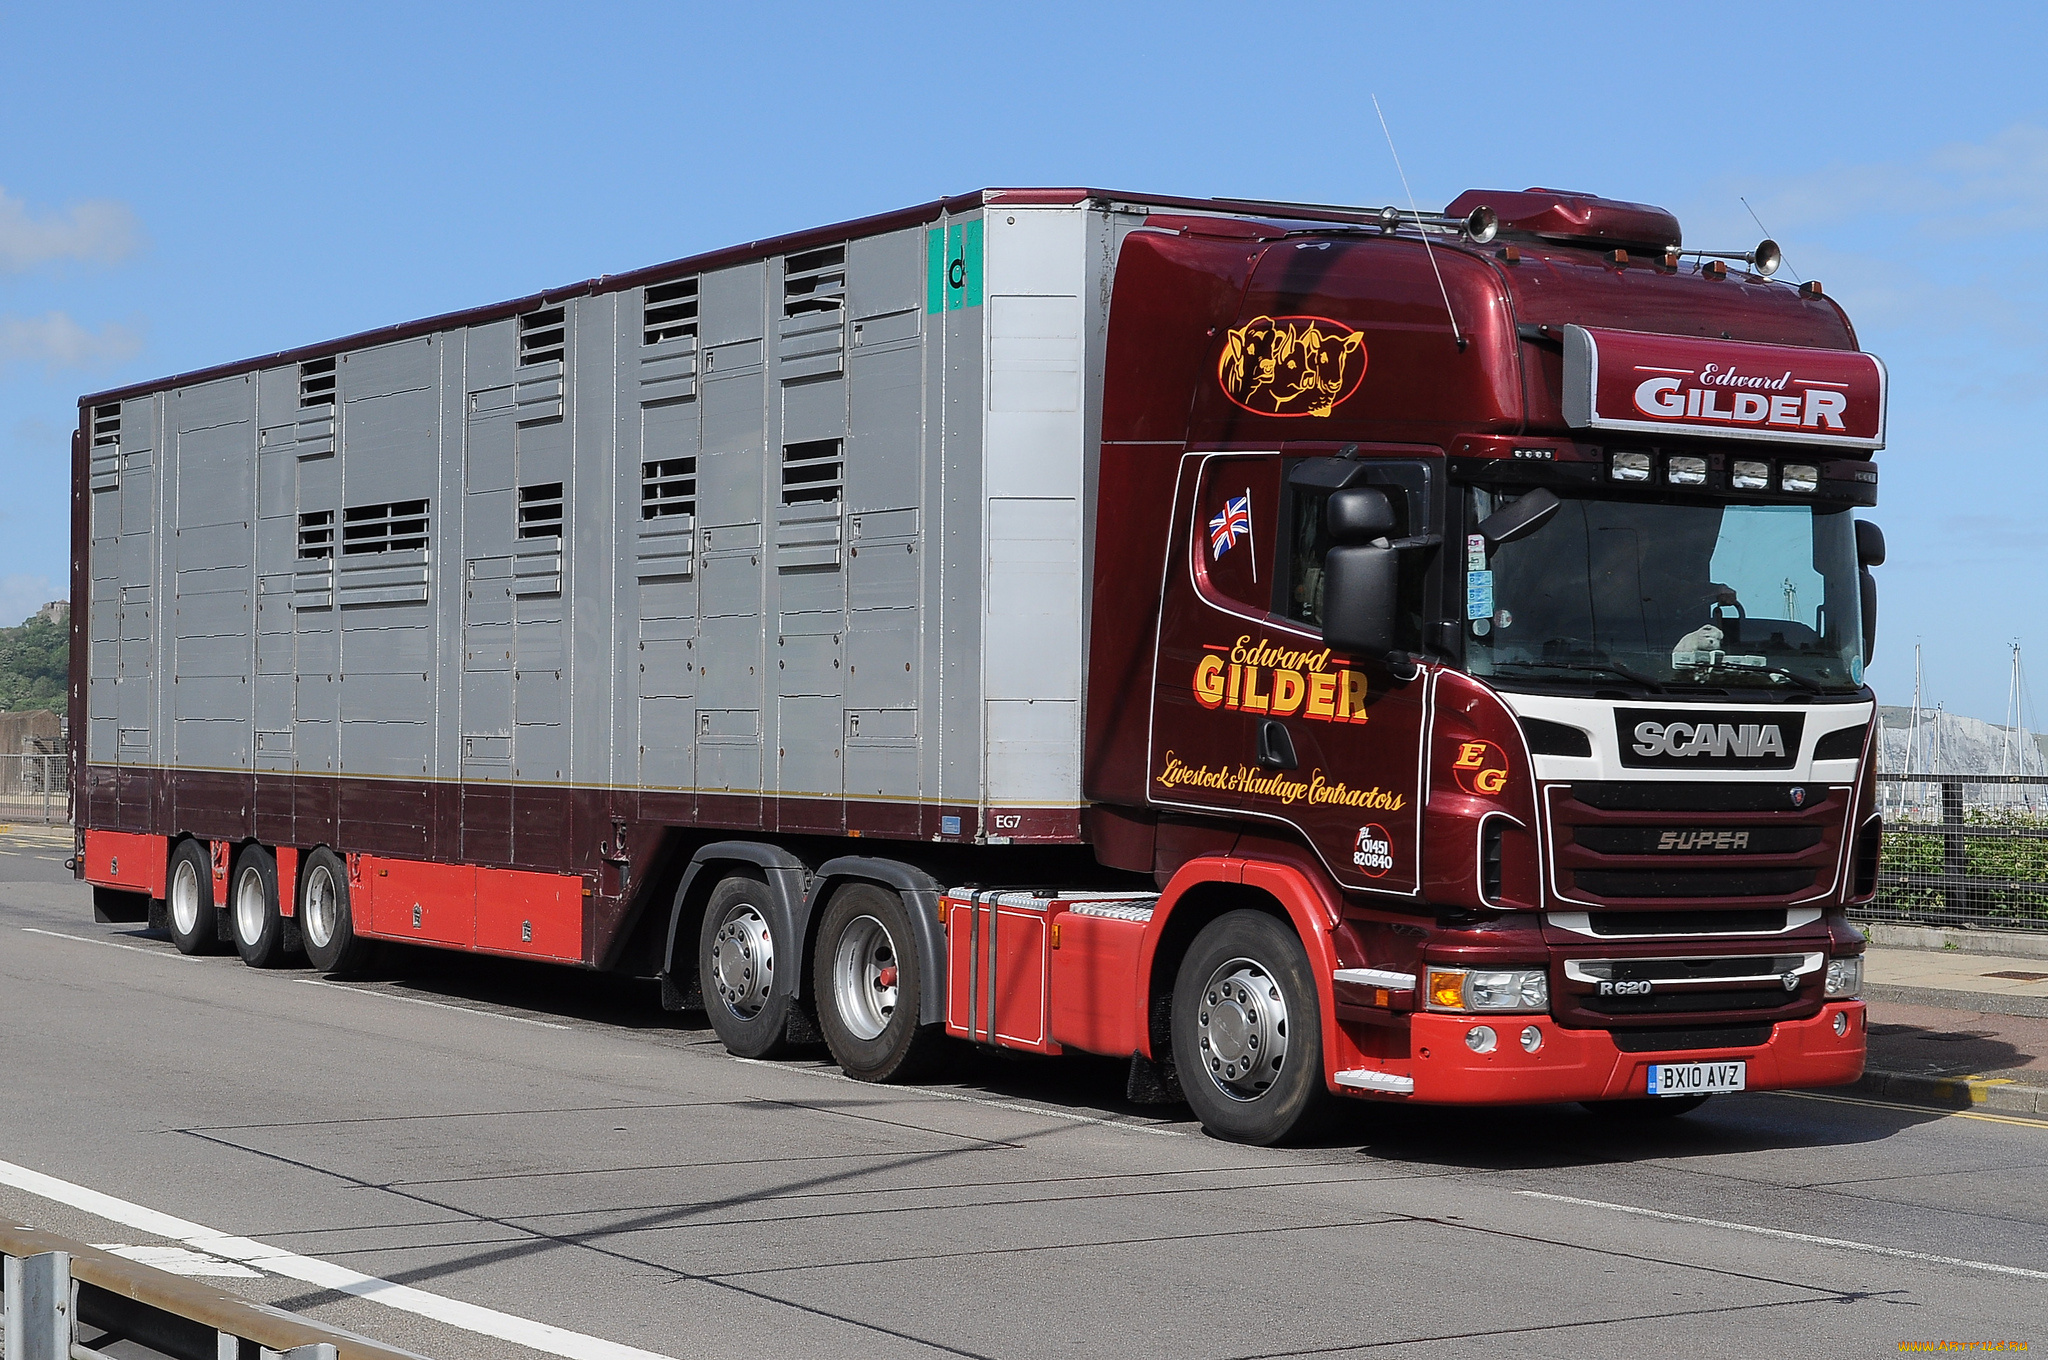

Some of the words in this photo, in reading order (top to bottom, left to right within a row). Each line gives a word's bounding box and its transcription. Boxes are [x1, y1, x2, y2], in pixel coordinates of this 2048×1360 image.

[1699, 362, 1792, 391] Edward
[1632, 376, 1848, 432] GILDER
[1230, 634, 1332, 673] Edward
[1192, 654, 1369, 725] GILDER
[1632, 721, 1786, 757] SCANIA
[1156, 750, 1229, 788] Livestock
[1237, 763, 1309, 805] Haulage
[1308, 767, 1407, 811] Contractors
[995, 815, 1021, 829] EG7
[1361, 839, 1388, 856] 01451
[1657, 831, 1750, 850] SUPER
[1353, 851, 1393, 870] 820840
[1600, 982, 1614, 995] R
[1615, 980, 1652, 995] 620
[1663, 1067, 1702, 1089] BX10
[1706, 1065, 1738, 1087] AVZ
